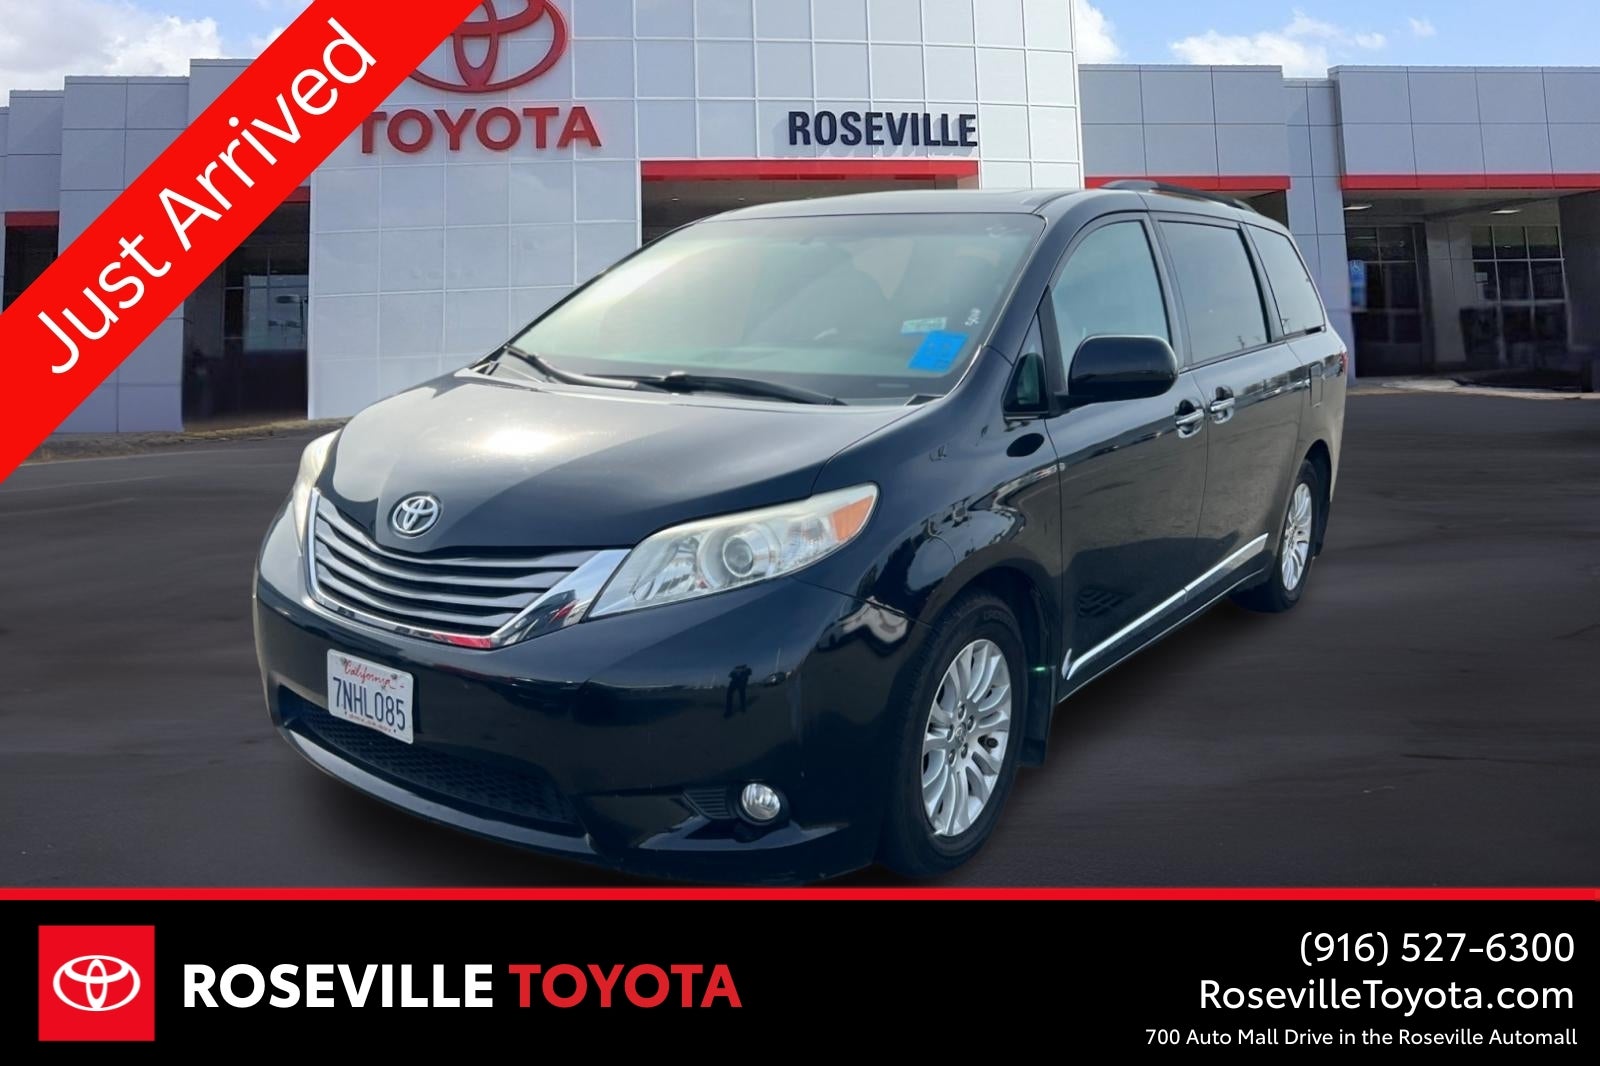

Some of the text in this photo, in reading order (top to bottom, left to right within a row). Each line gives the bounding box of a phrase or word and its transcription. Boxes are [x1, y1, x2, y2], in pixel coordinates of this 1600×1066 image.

[362, 106, 602, 154] TOYOTA
[788, 111, 978, 147] ROSEVILLE
[333, 676, 406, 731] 7NHL085
